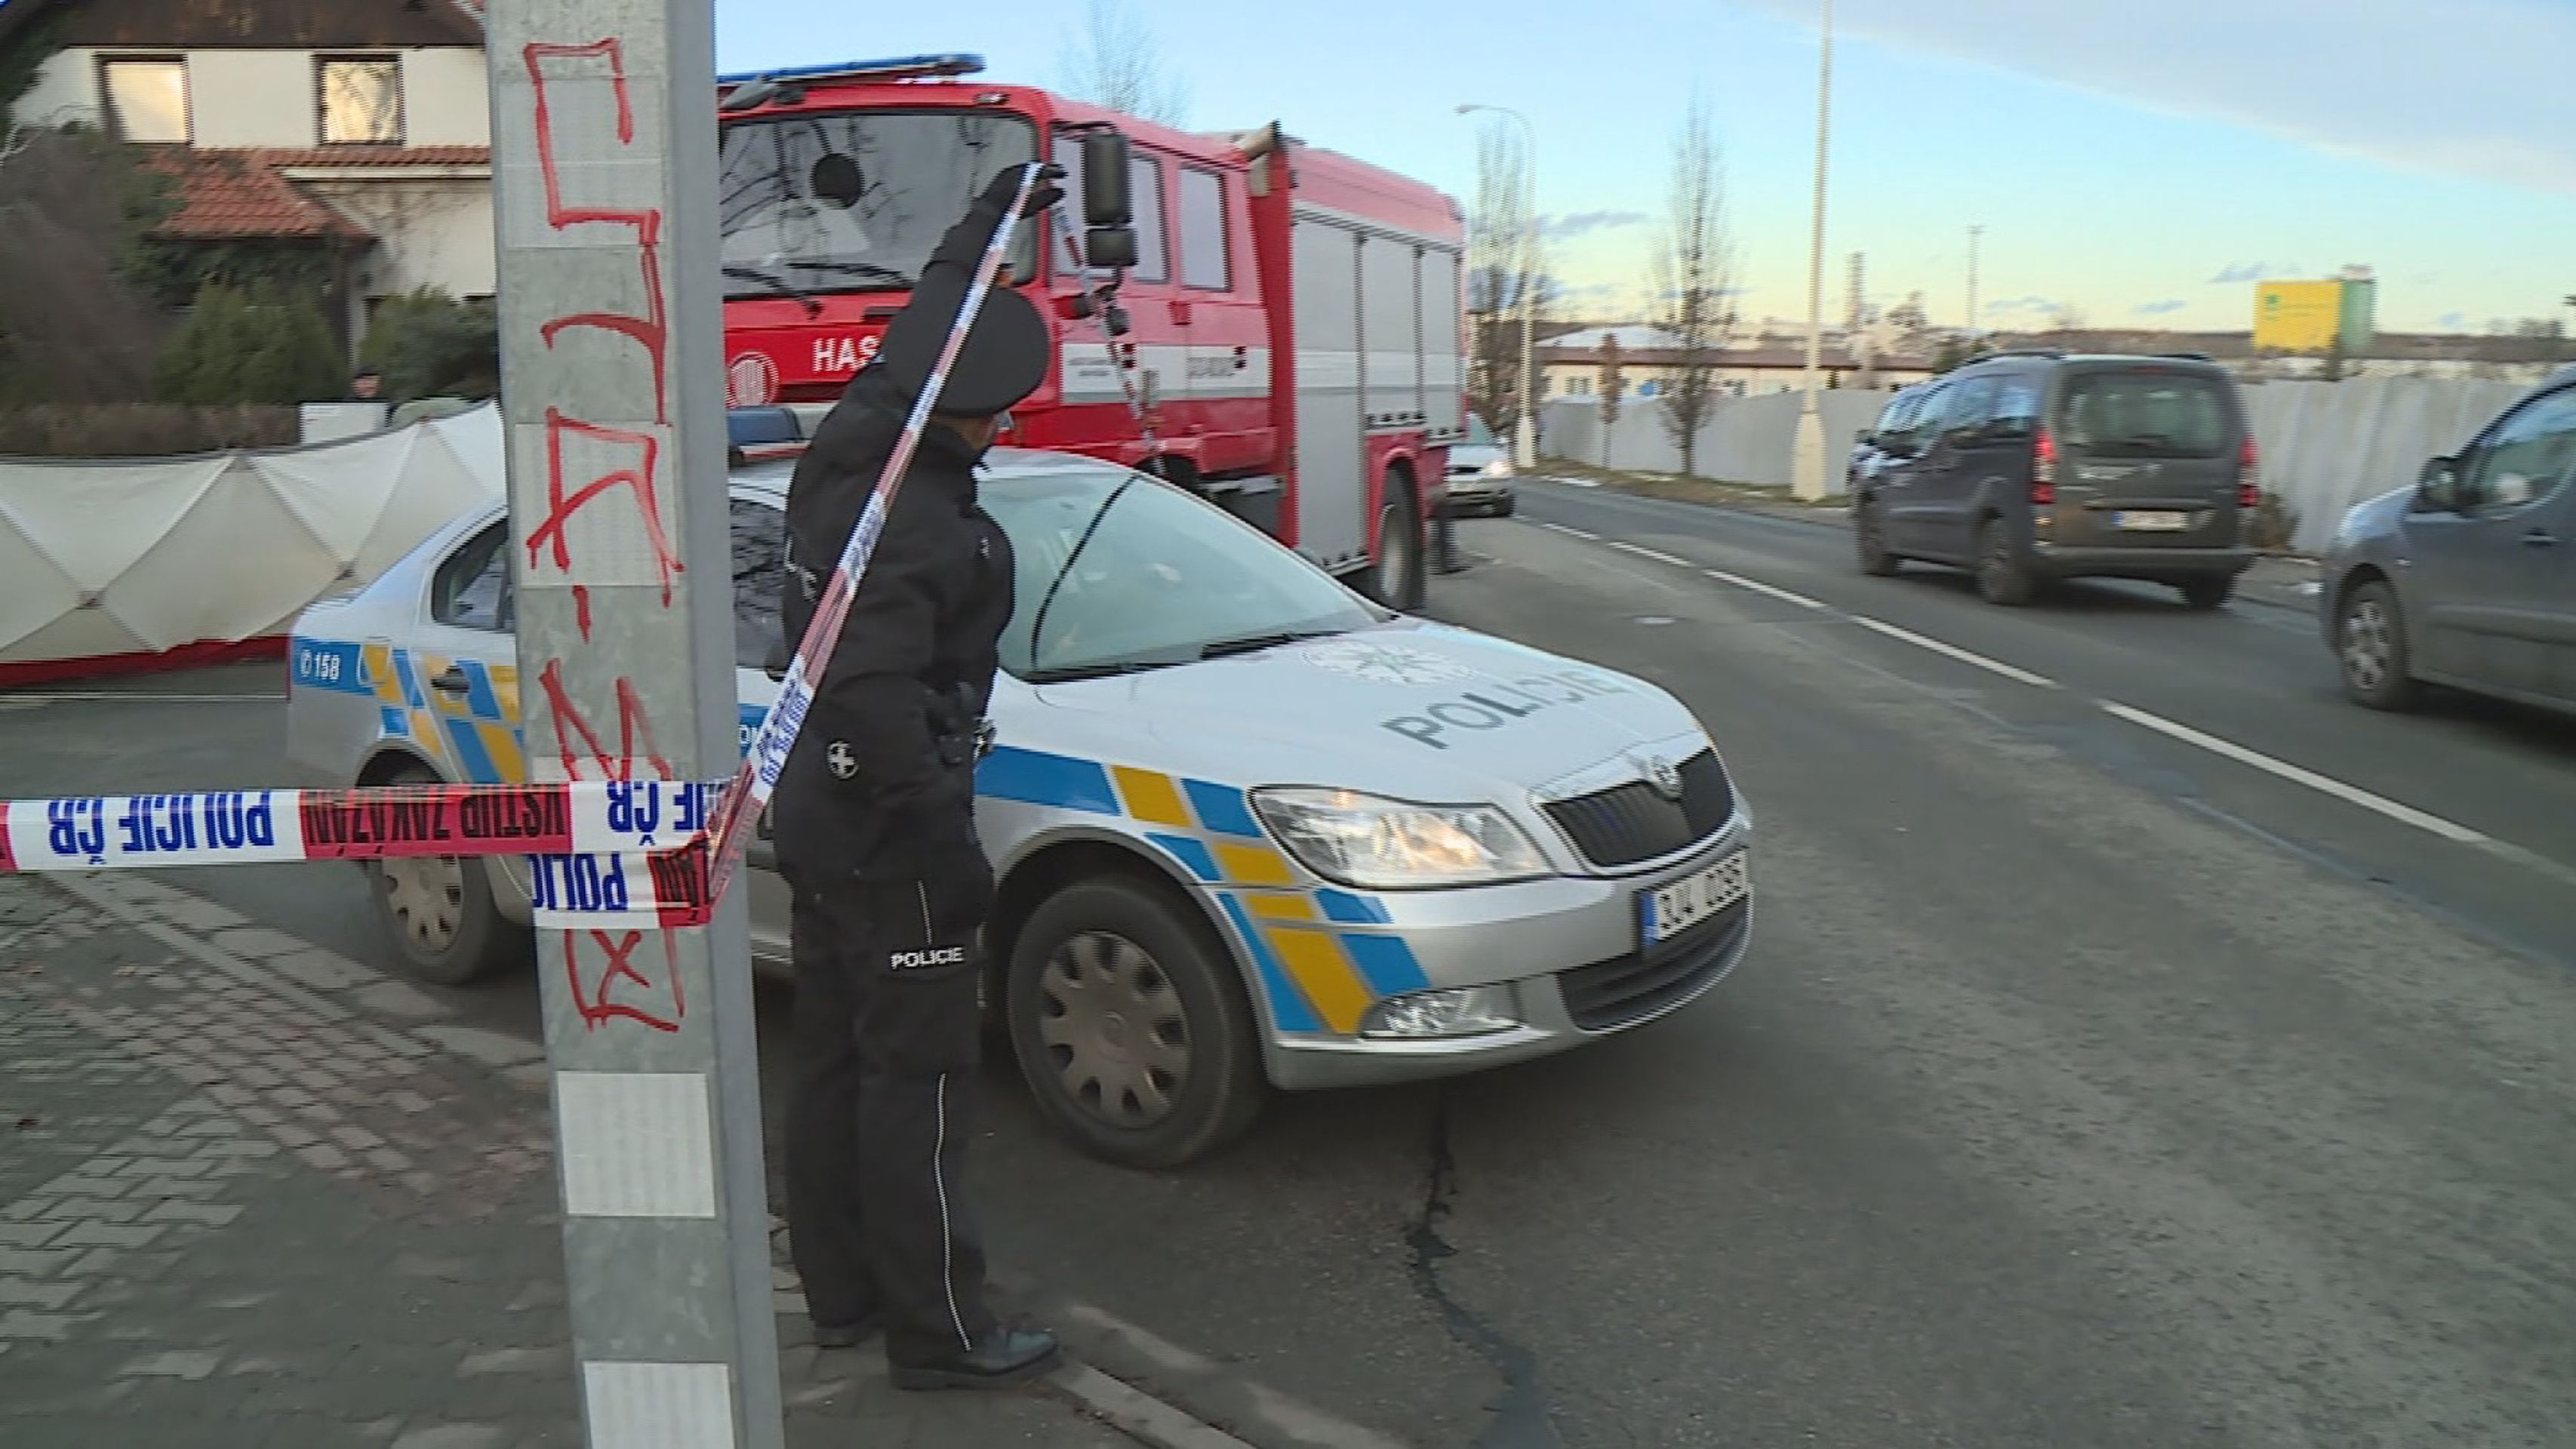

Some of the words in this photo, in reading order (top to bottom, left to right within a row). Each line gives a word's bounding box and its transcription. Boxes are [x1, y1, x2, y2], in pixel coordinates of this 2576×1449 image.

[315, 652, 340, 681] 158
[1380, 670, 1634, 749] POLICIE
[48, 798, 106, 865] ČR
[118, 790, 275, 853] POLICIE
[460, 789, 565, 838] VSTUP
[890, 947, 966, 970] POLICIE
